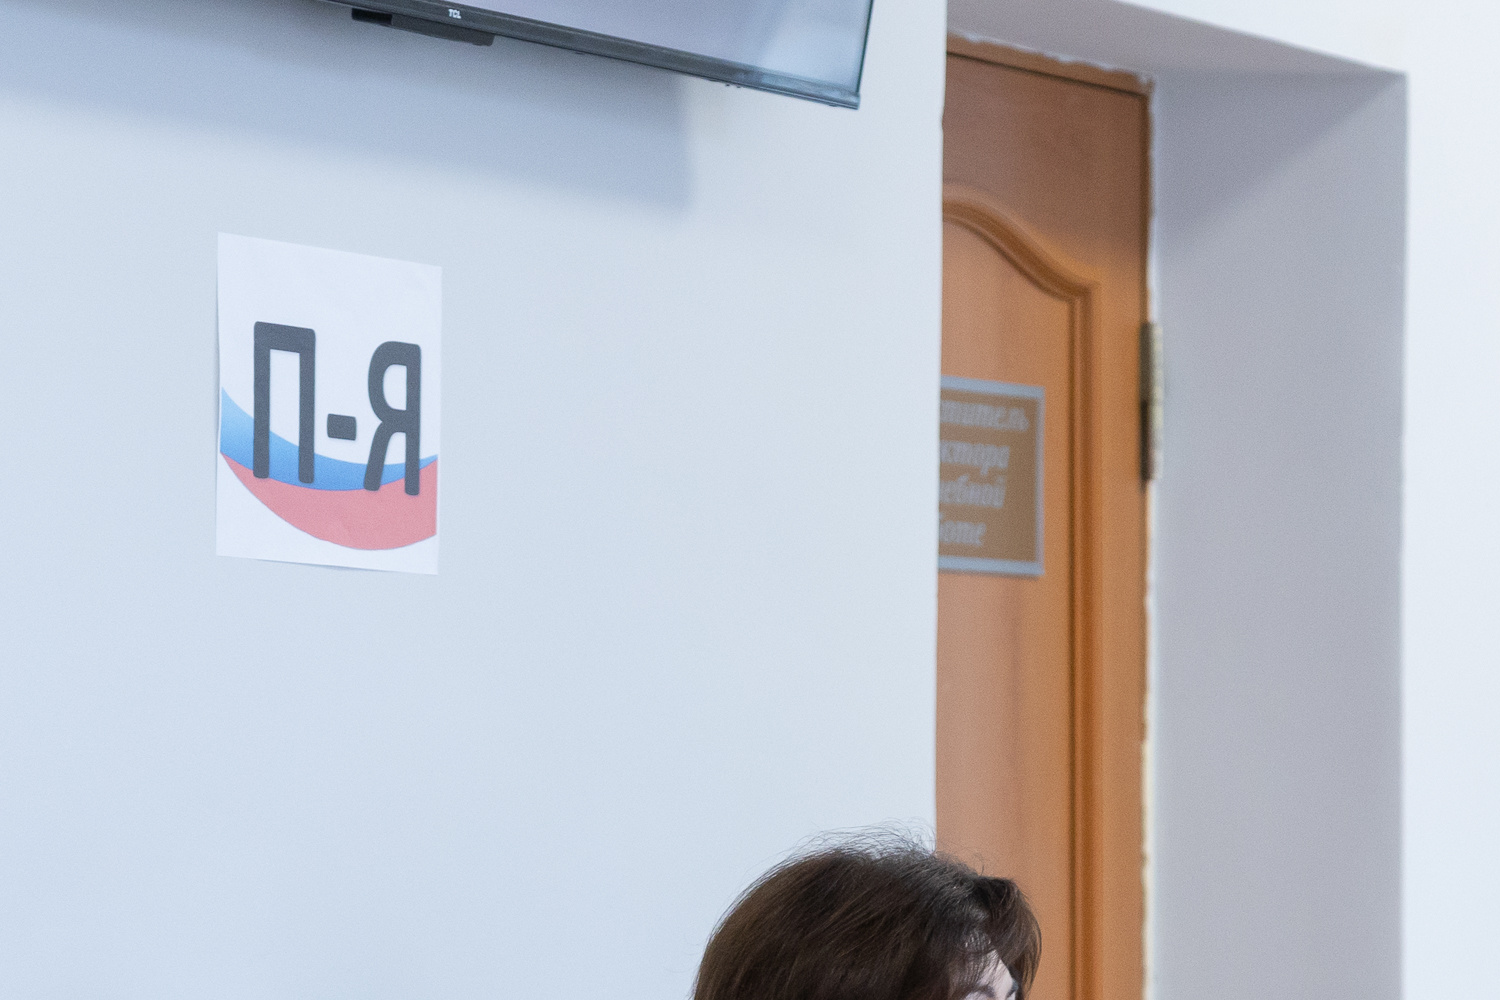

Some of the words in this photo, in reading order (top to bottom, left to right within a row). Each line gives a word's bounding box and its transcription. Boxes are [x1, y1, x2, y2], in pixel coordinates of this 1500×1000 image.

[449, 8, 461, 19] TCL
[252, 320, 423, 497] П-Я
[941, 400, 1030, 432] титель
[940, 440, 1010, 476] ктора
